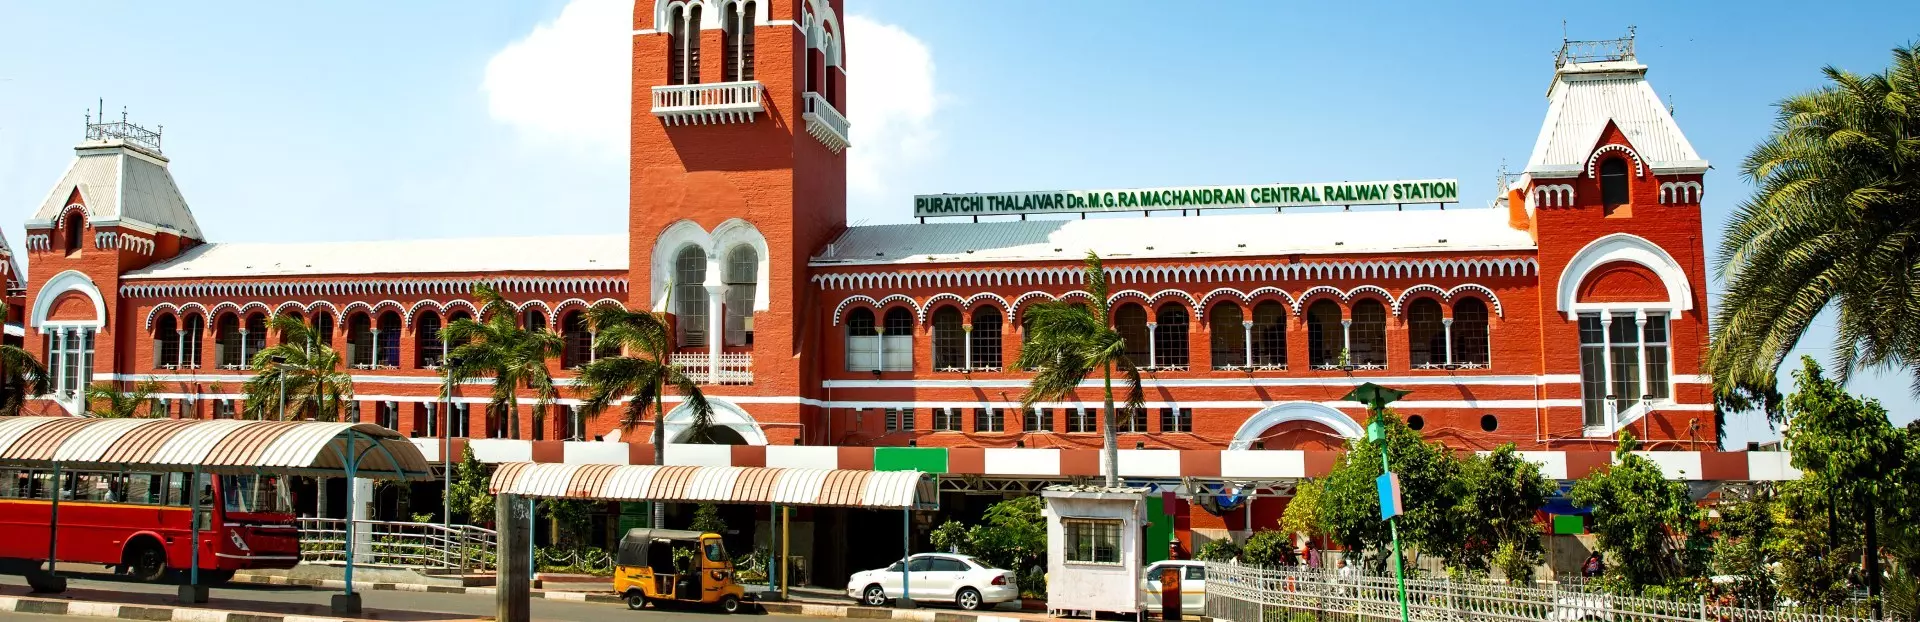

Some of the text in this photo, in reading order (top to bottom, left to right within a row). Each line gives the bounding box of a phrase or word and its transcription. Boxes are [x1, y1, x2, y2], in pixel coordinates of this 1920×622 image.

[917, 196, 983, 213] PURATCHI
[987, 193, 1064, 211] THALAIVAR
[1251, 186, 1320, 203] CENTRAL
[1324, 184, 1388, 201] RAILWAY
[1393, 182, 1456, 199] STATION
